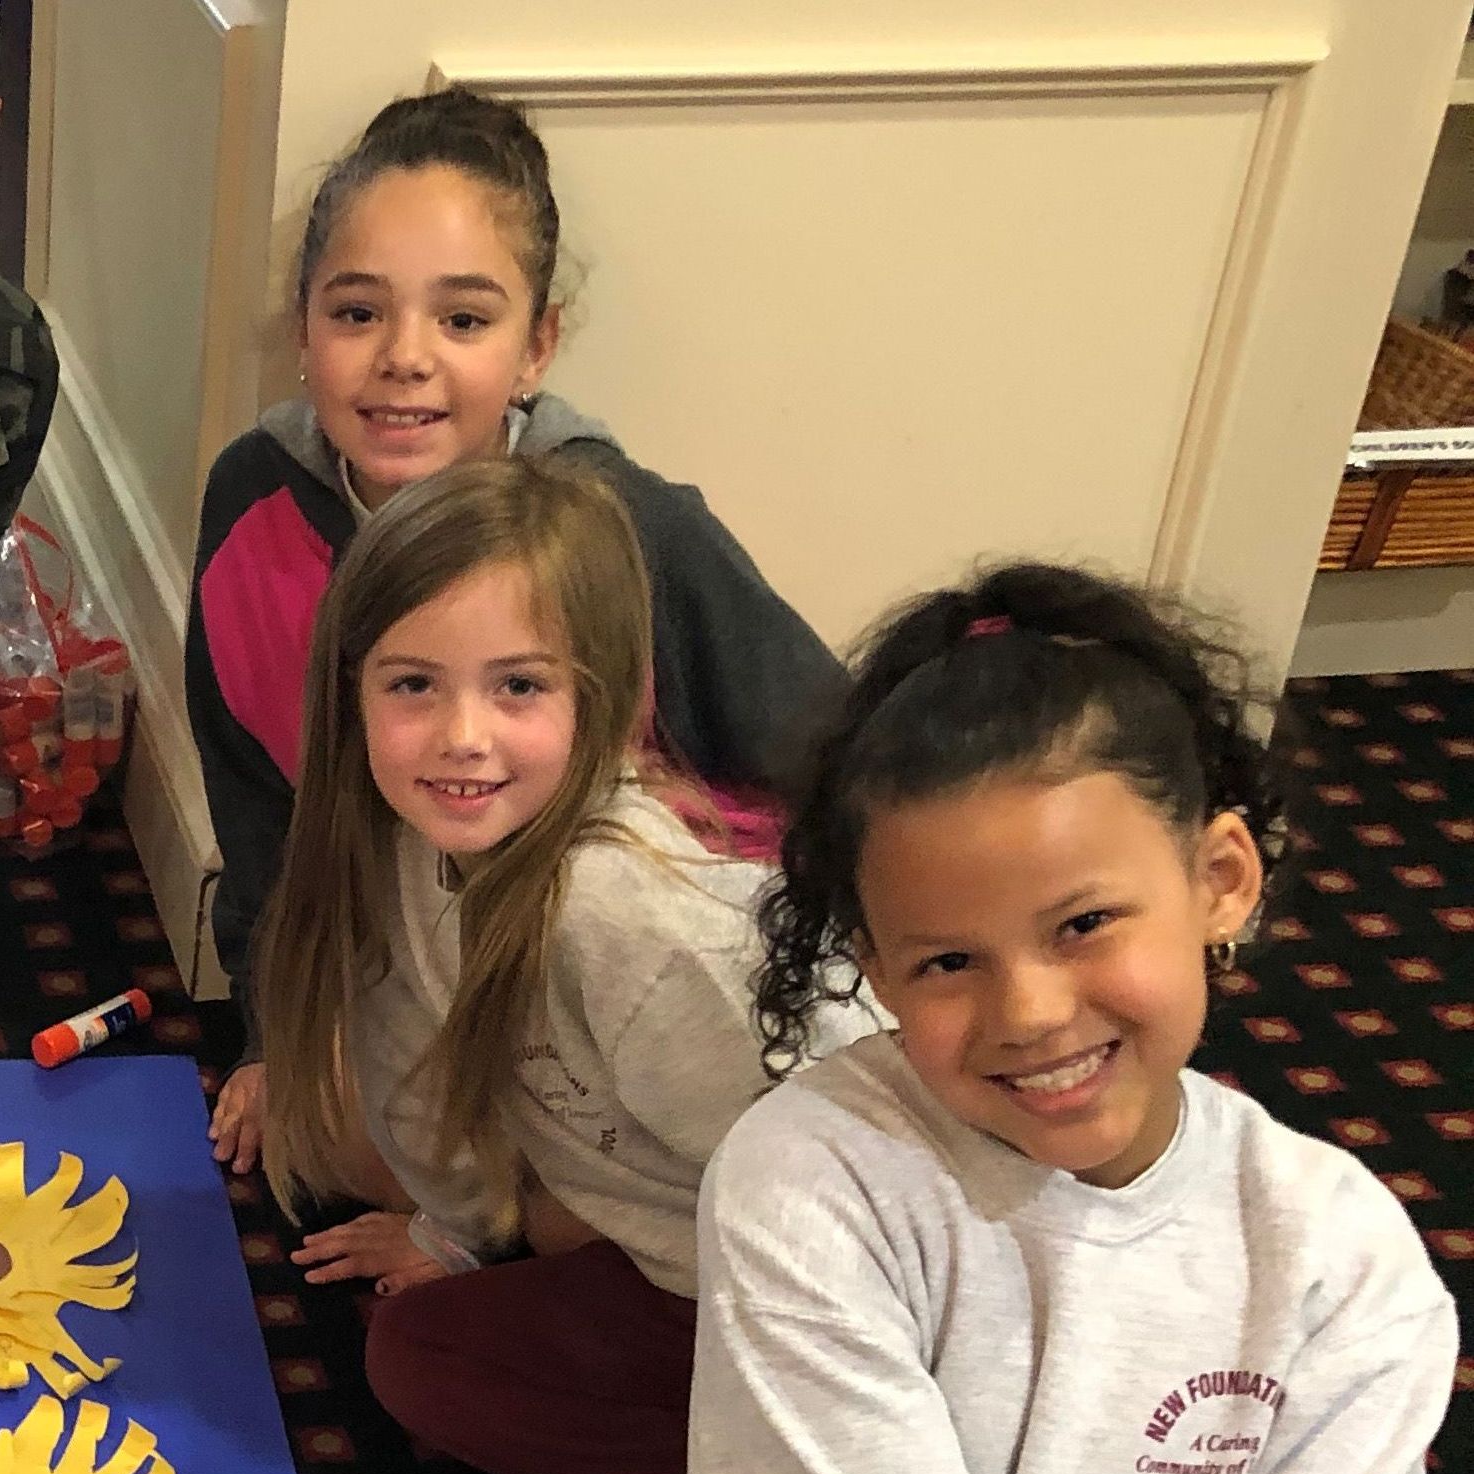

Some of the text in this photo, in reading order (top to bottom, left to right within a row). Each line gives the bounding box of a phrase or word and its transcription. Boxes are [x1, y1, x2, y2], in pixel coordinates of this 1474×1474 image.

[1145, 1389, 1187, 1443] NEW
[1190, 1433, 1261, 1454] A Caring
